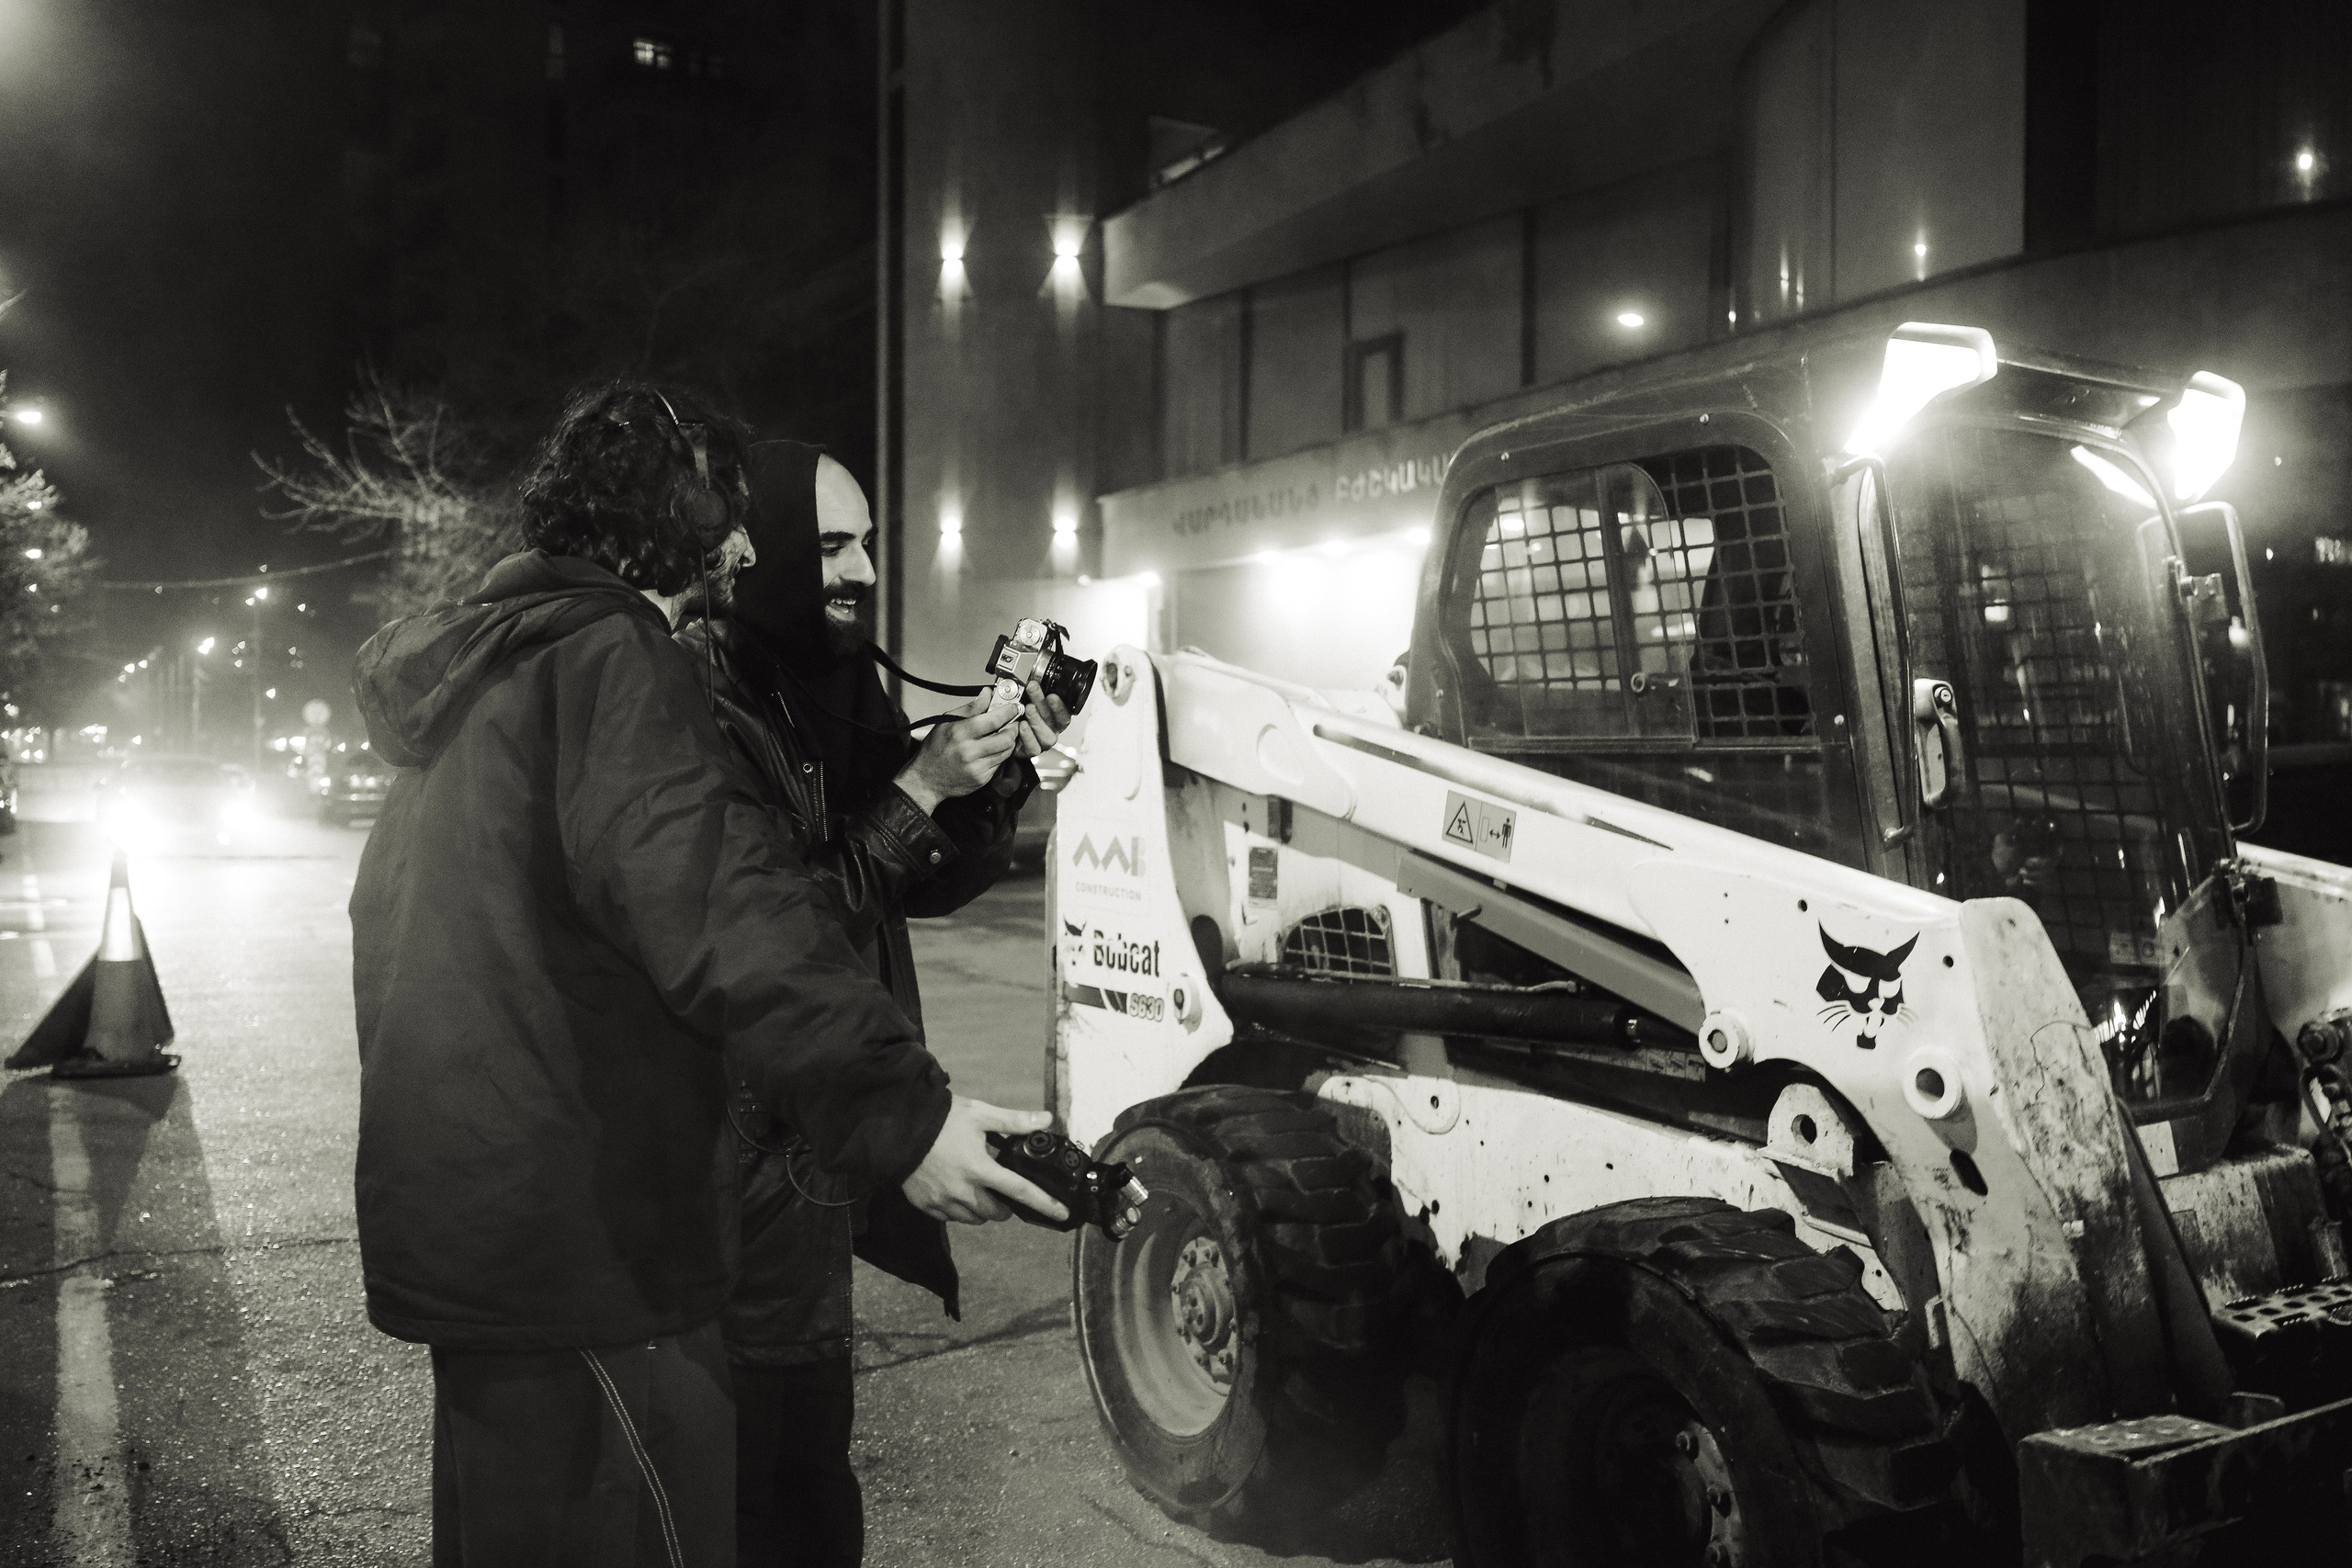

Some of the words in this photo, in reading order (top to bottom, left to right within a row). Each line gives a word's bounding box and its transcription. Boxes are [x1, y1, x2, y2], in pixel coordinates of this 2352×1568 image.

[1336, 453, 1453, 502] ԲԺՇԿԱԿԱ
[1075, 882, 1142, 901] CONSTRUCTION
[1093, 930, 1159, 977] Bobcat
[1130, 993, 1164, 1021] S630
